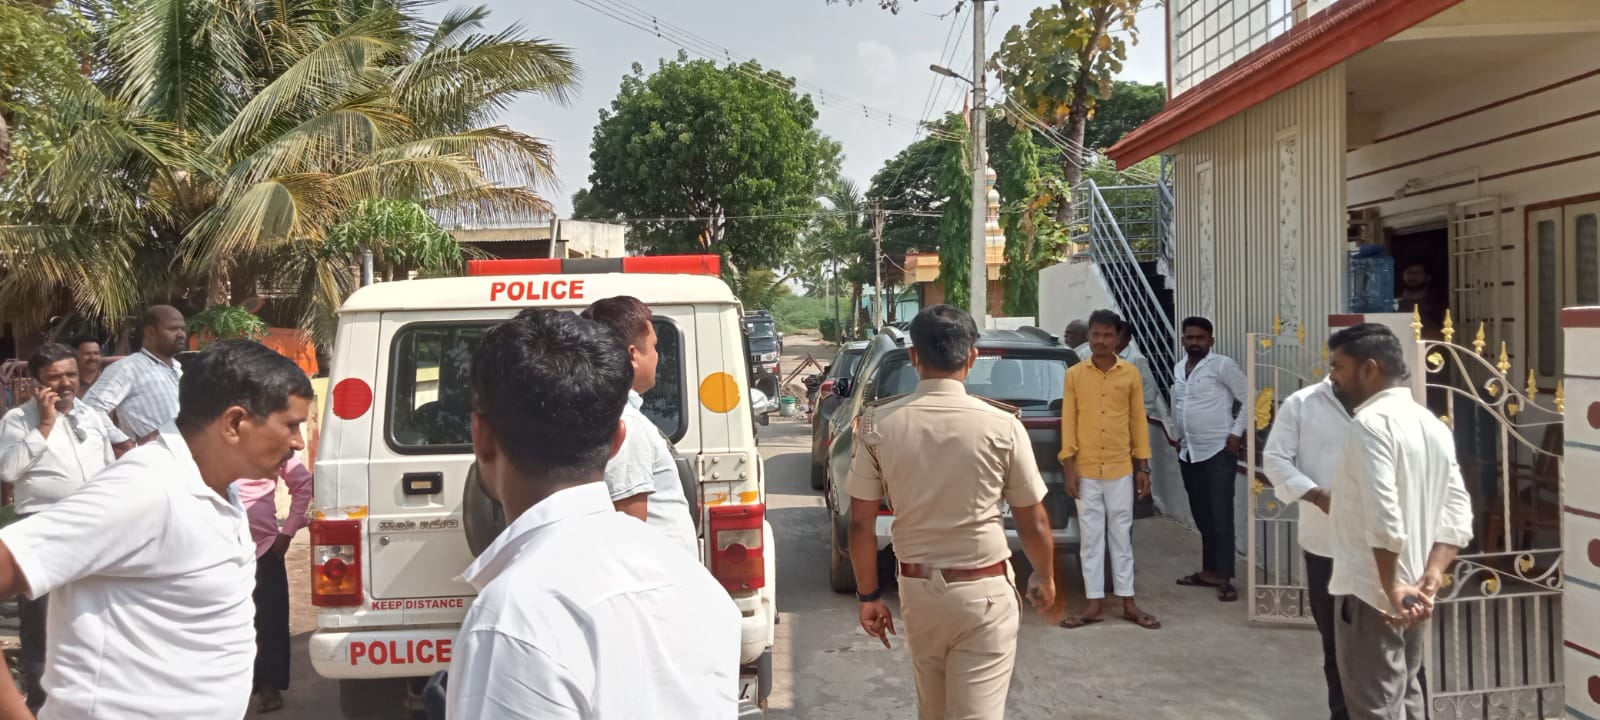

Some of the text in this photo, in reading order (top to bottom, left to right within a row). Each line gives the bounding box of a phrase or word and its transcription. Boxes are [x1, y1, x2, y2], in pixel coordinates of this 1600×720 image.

[490, 280, 584, 301] POLICE
[371, 599, 464, 610] KEEP DISTANCE
[350, 639, 452, 665] POLICE
